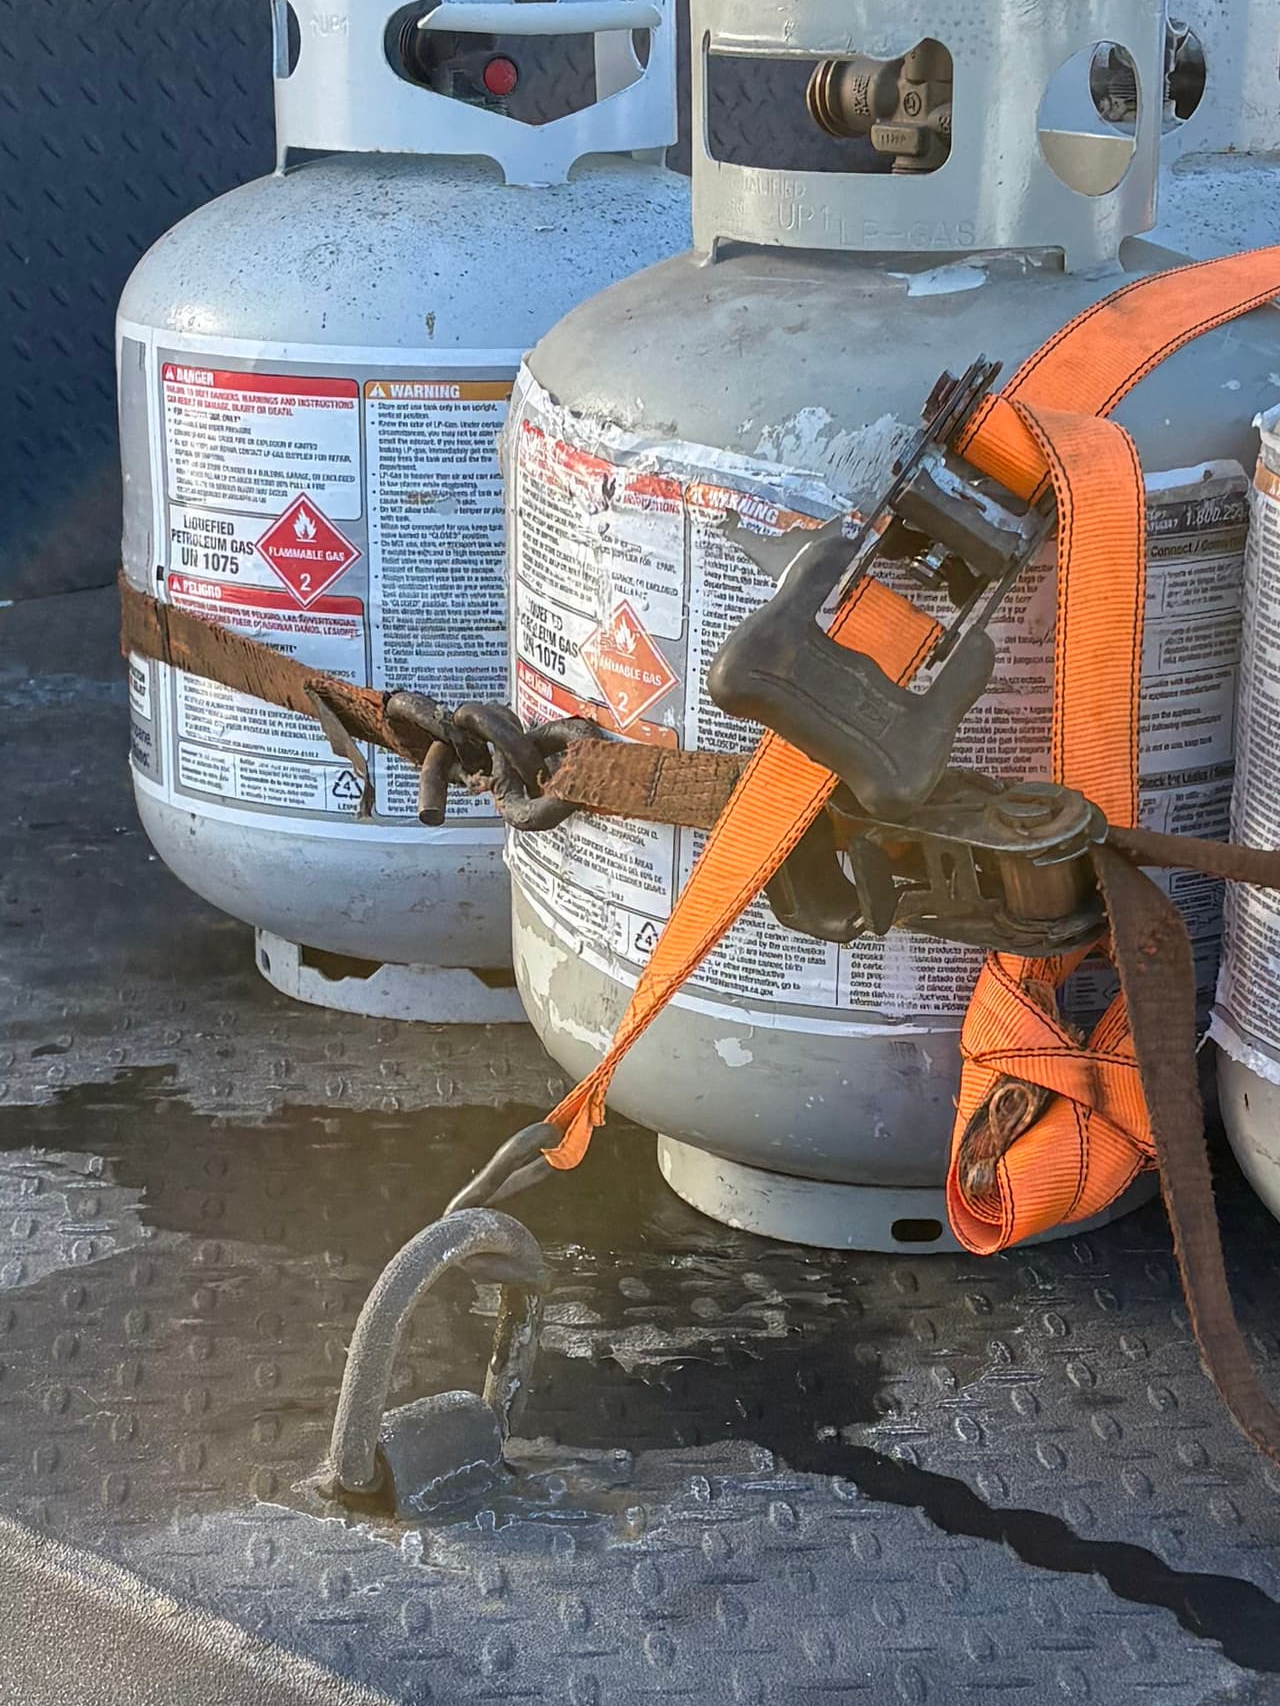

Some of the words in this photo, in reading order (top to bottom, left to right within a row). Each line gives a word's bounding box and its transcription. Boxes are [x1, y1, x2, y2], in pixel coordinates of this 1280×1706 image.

[177, 368, 214, 386] DANGER
[391, 385, 460, 398] WARNING
[242, 394, 278, 405] WARNINGS
[281, 398, 296, 406] AND
[298, 399, 354, 409] INSTRUCTIONS
[184, 514, 234, 536] LIQUEFIED
[171, 528, 227, 551] PETROLEUM
[231, 542, 254, 555] GAS
[181, 547, 197, 567] UN
[204, 553, 239, 574] 1075
[270, 546, 322, 560] FLAMMABLE
[326, 551, 345, 562] GAS
[183, 580, 221, 598] PELIGRO
[300, 573, 312, 591] 2
[559, 637, 579, 658] GAS
[536, 643, 566, 675] 1075
[643, 667, 662, 685] GAS
[618, 692, 628, 712] 2
[342, 782, 351, 791] 4
